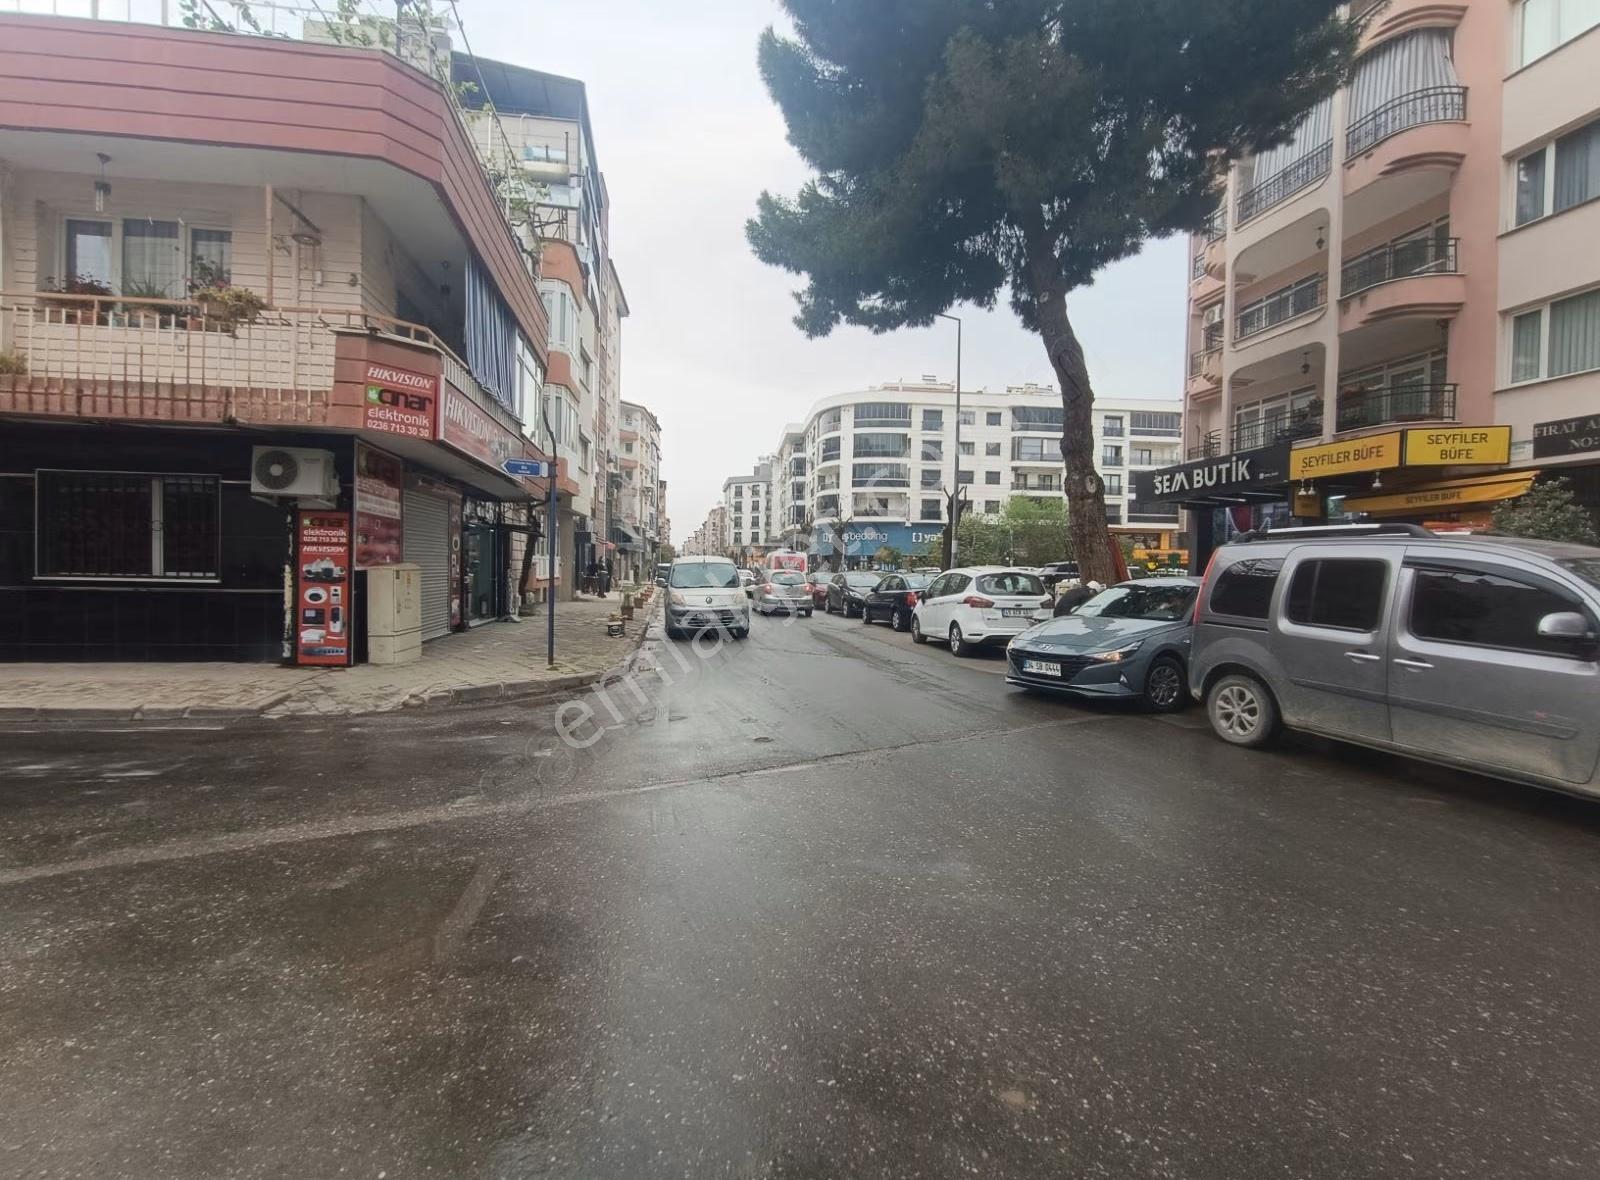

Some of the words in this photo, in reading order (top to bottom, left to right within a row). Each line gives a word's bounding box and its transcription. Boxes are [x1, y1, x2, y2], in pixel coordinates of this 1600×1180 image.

[368, 367, 432, 389] HIKVISION
[368, 407, 429, 427] elektronik
[445, 393, 489, 442] HIKVISION
[367, 419, 388, 430] 0236
[390, 423, 405, 434] 713
[407, 427, 417, 436] 30
[1535, 422, 1576, 437] FIRAT
[1427, 431, 1488, 445] SEYFİLER
[1302, 450, 1350, 468] SEYFİLER
[1353, 445, 1384, 461] BÜFE
[1440, 447, 1473, 460] BÜFE
[1193, 456, 1250, 488] BUTİK
